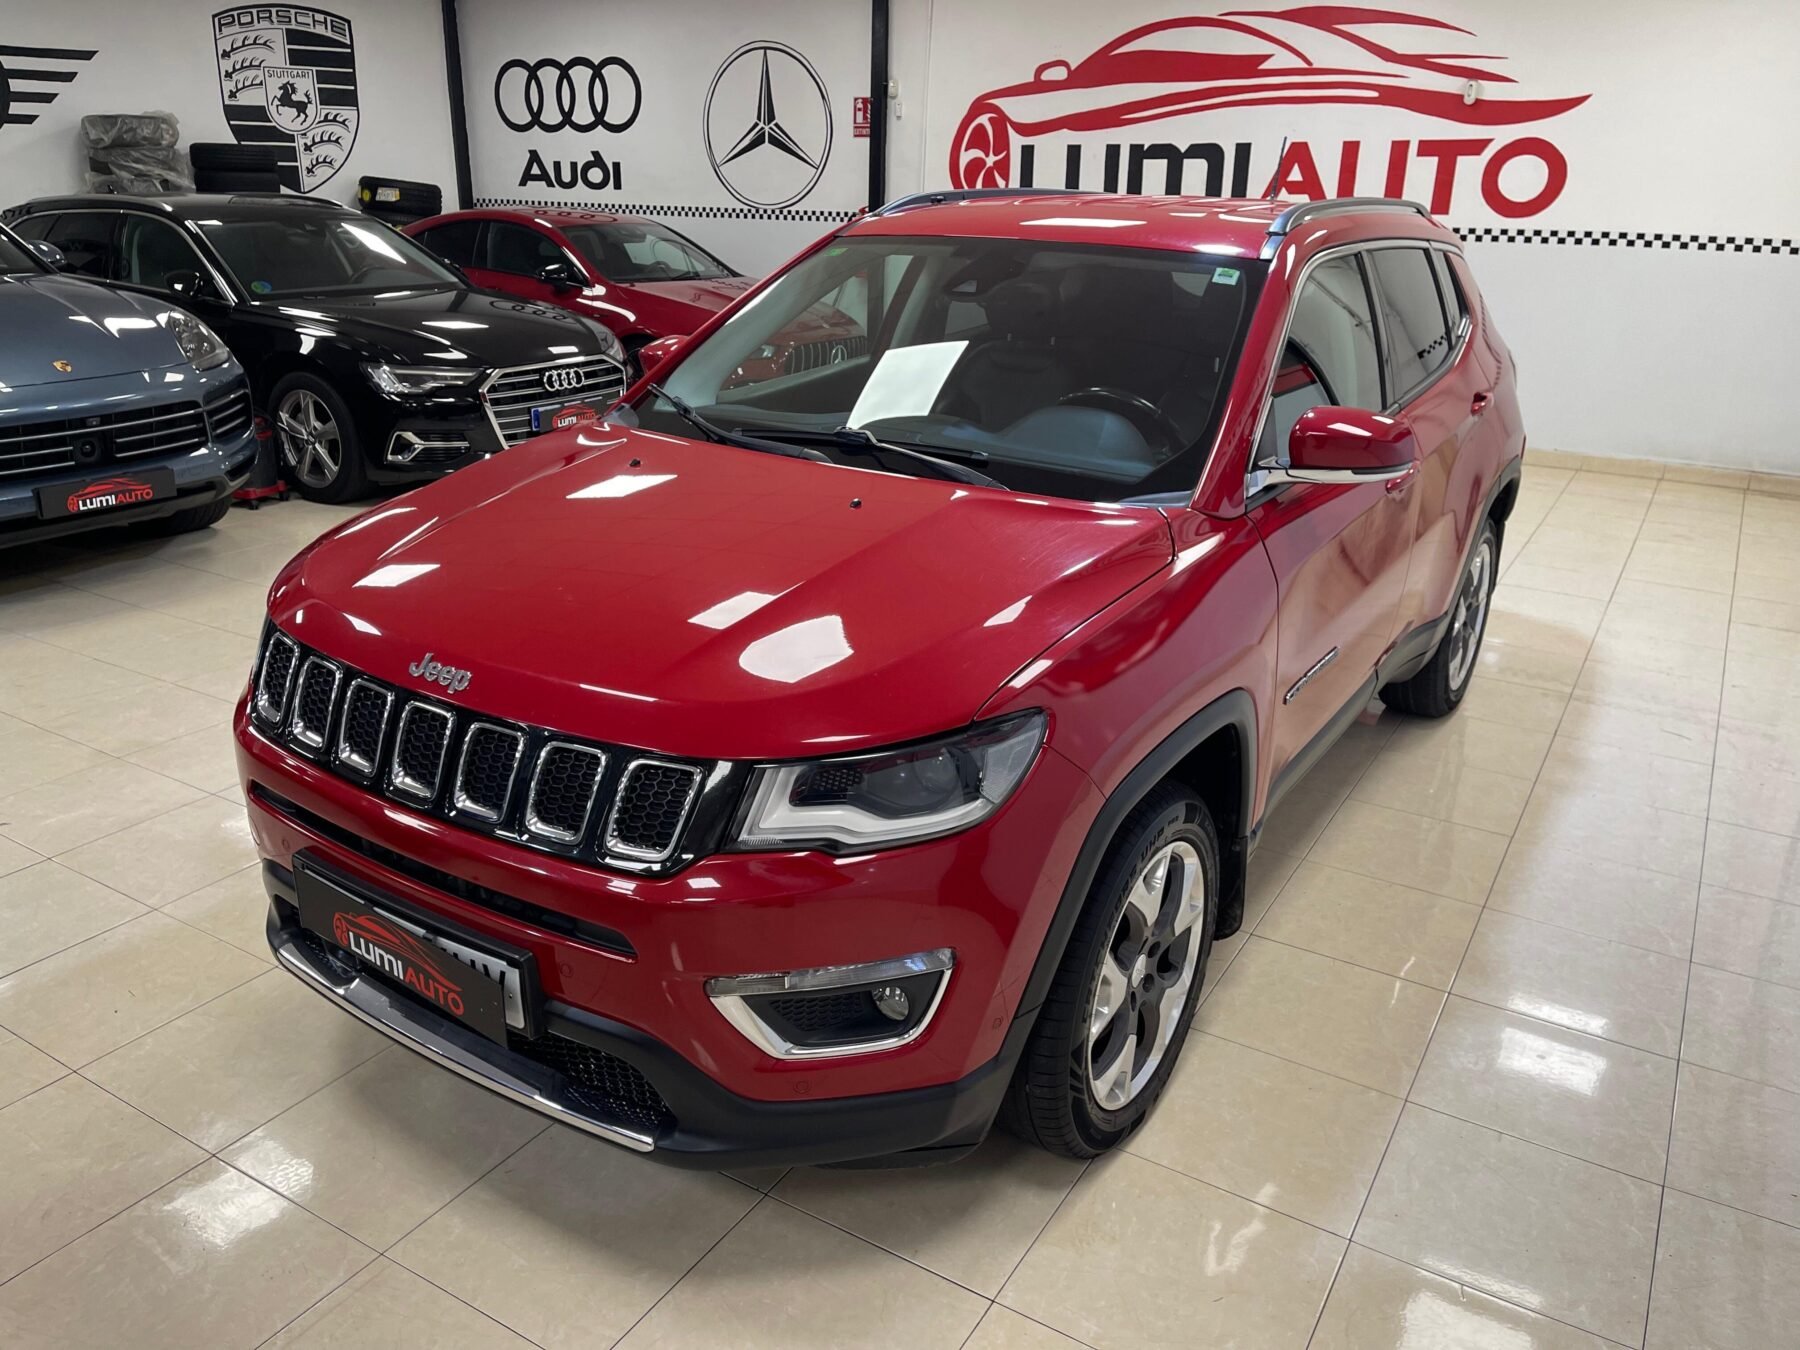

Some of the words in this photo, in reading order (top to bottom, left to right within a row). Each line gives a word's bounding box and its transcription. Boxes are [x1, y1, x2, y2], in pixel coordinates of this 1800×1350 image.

[217, 9, 348, 38] PORSCHE
[267, 69, 310, 79] STUTTGART
[518, 149, 622, 190] Audi
[408, 652, 472, 694] Jeep
